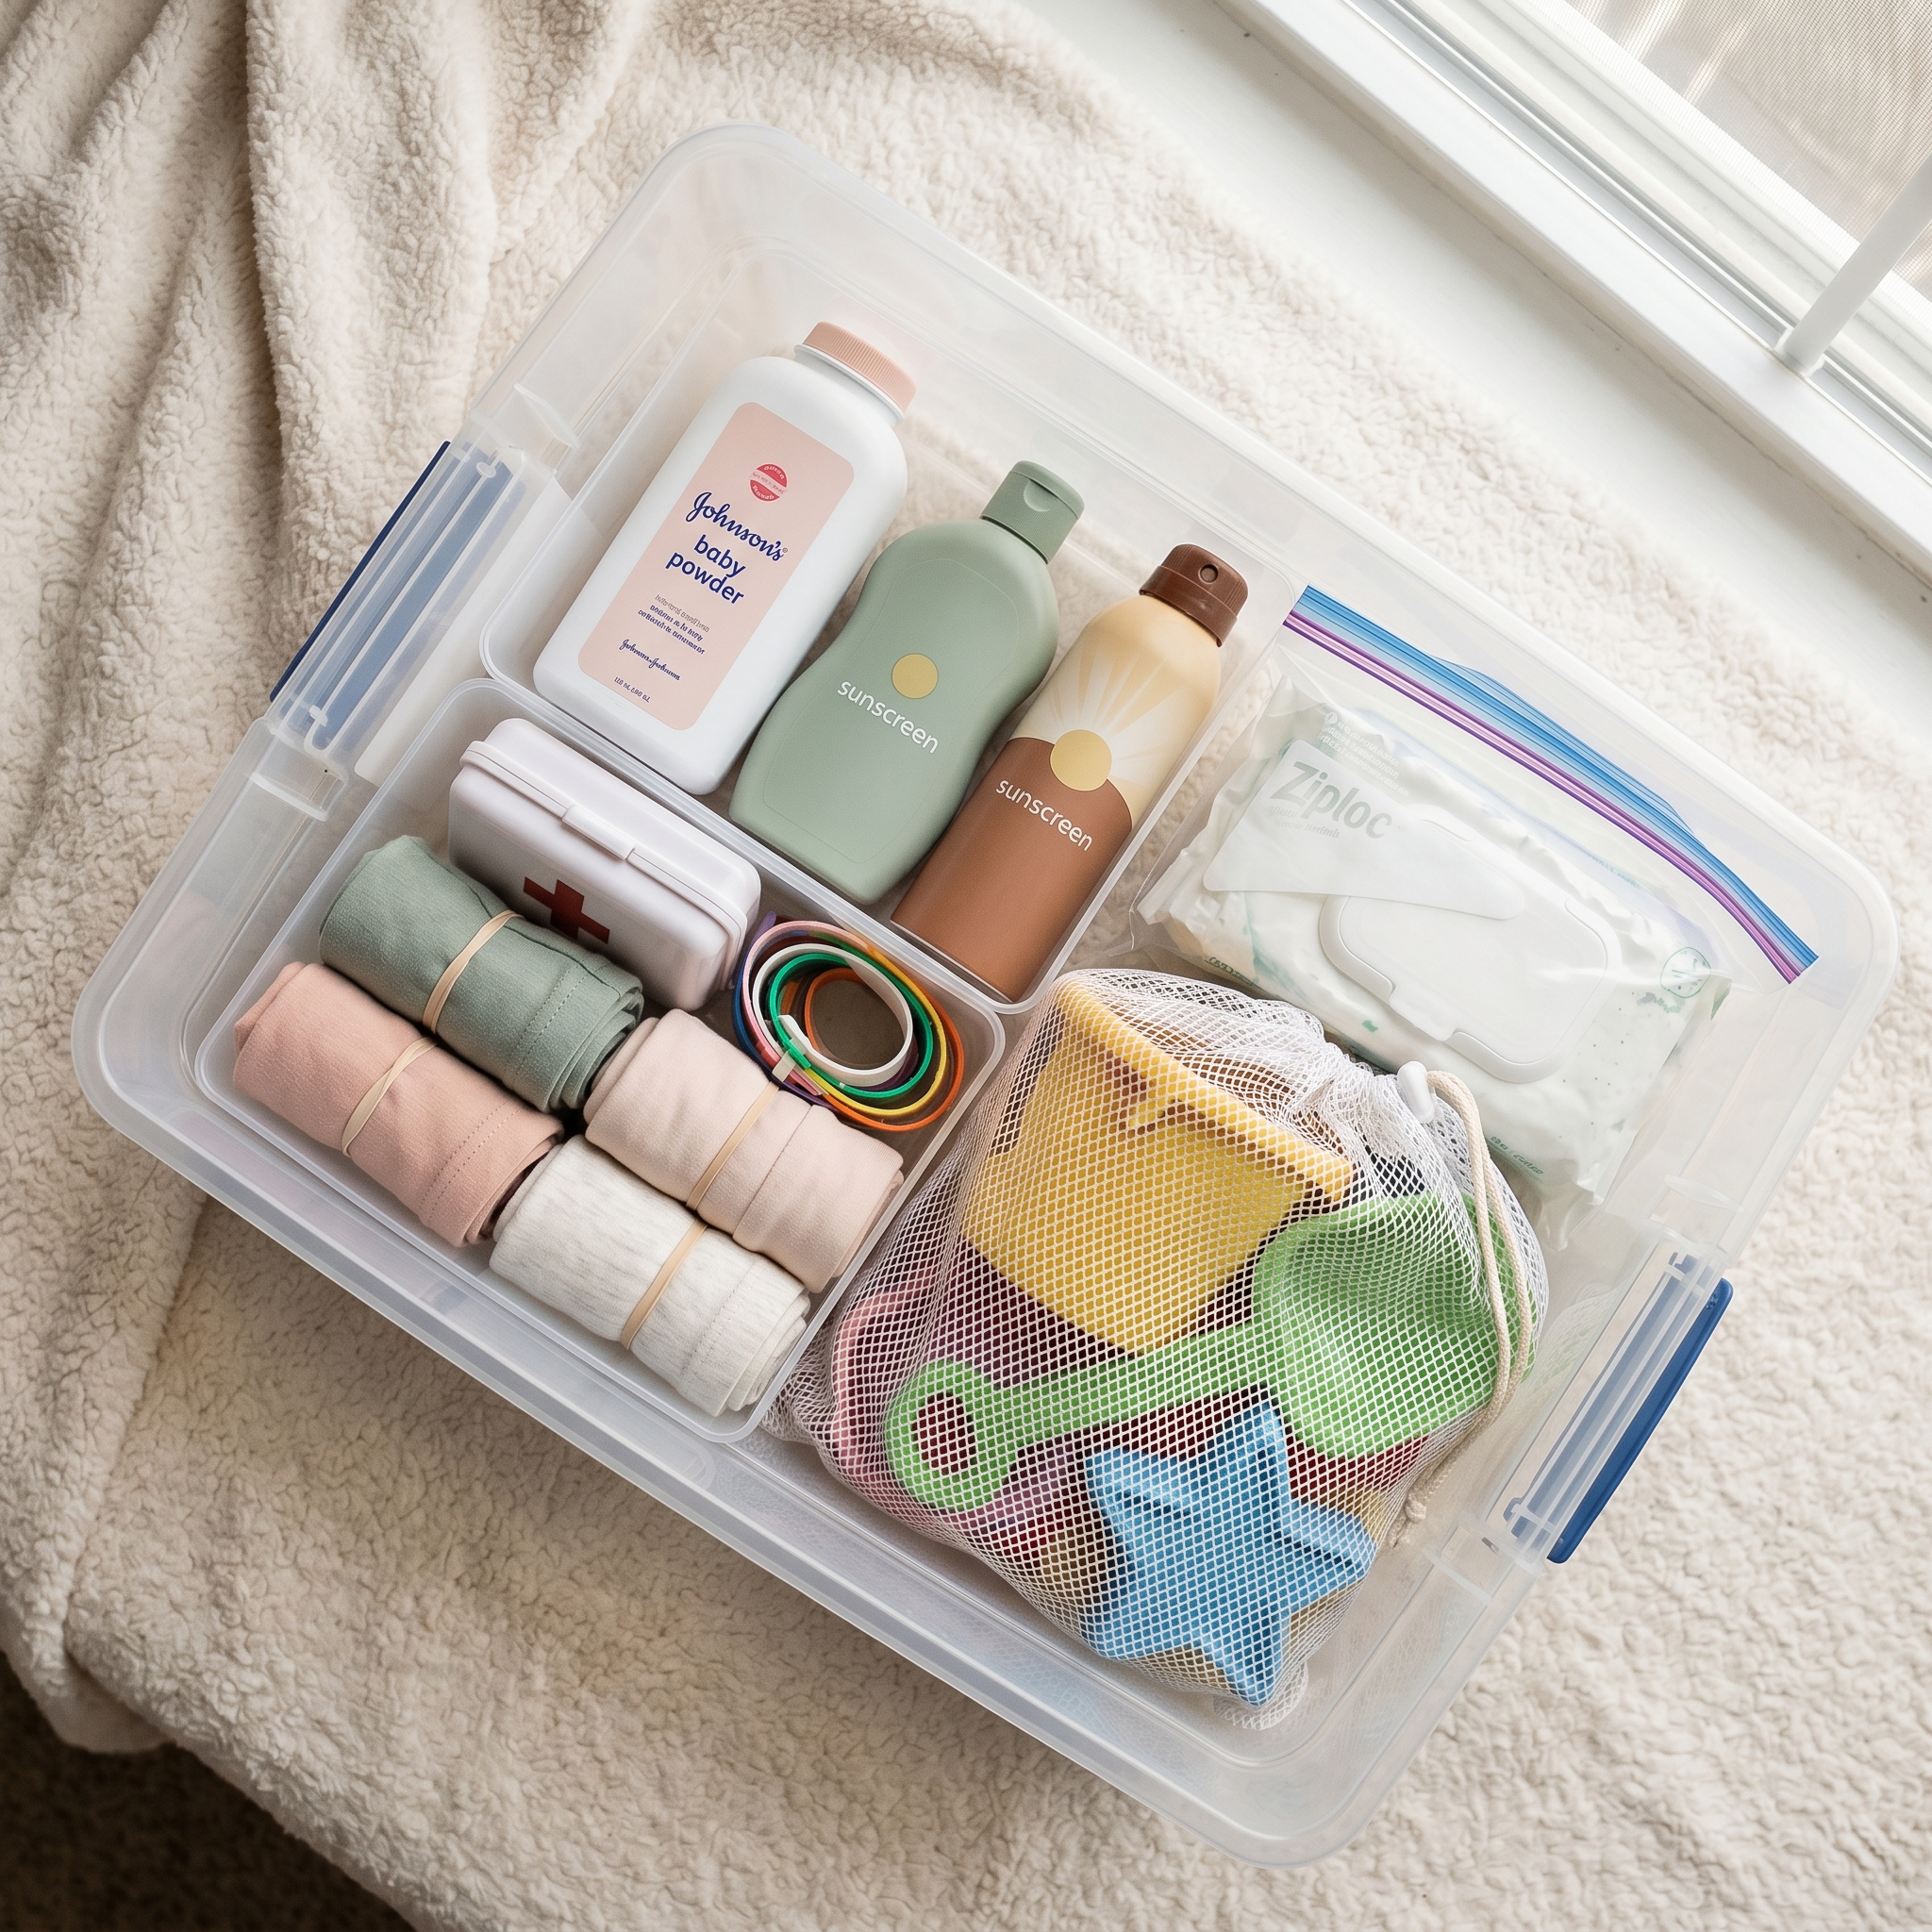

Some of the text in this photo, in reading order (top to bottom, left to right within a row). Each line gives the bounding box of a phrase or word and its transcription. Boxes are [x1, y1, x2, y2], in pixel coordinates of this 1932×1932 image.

[686, 491, 784, 561] Johnson's
[693, 534, 746, 577] baby
[665, 552, 744, 604] powder
[837, 680, 940, 754] sunscreen
[995, 779, 1093, 852] sunscreen
[1269, 760, 1392, 839] Ziploc
